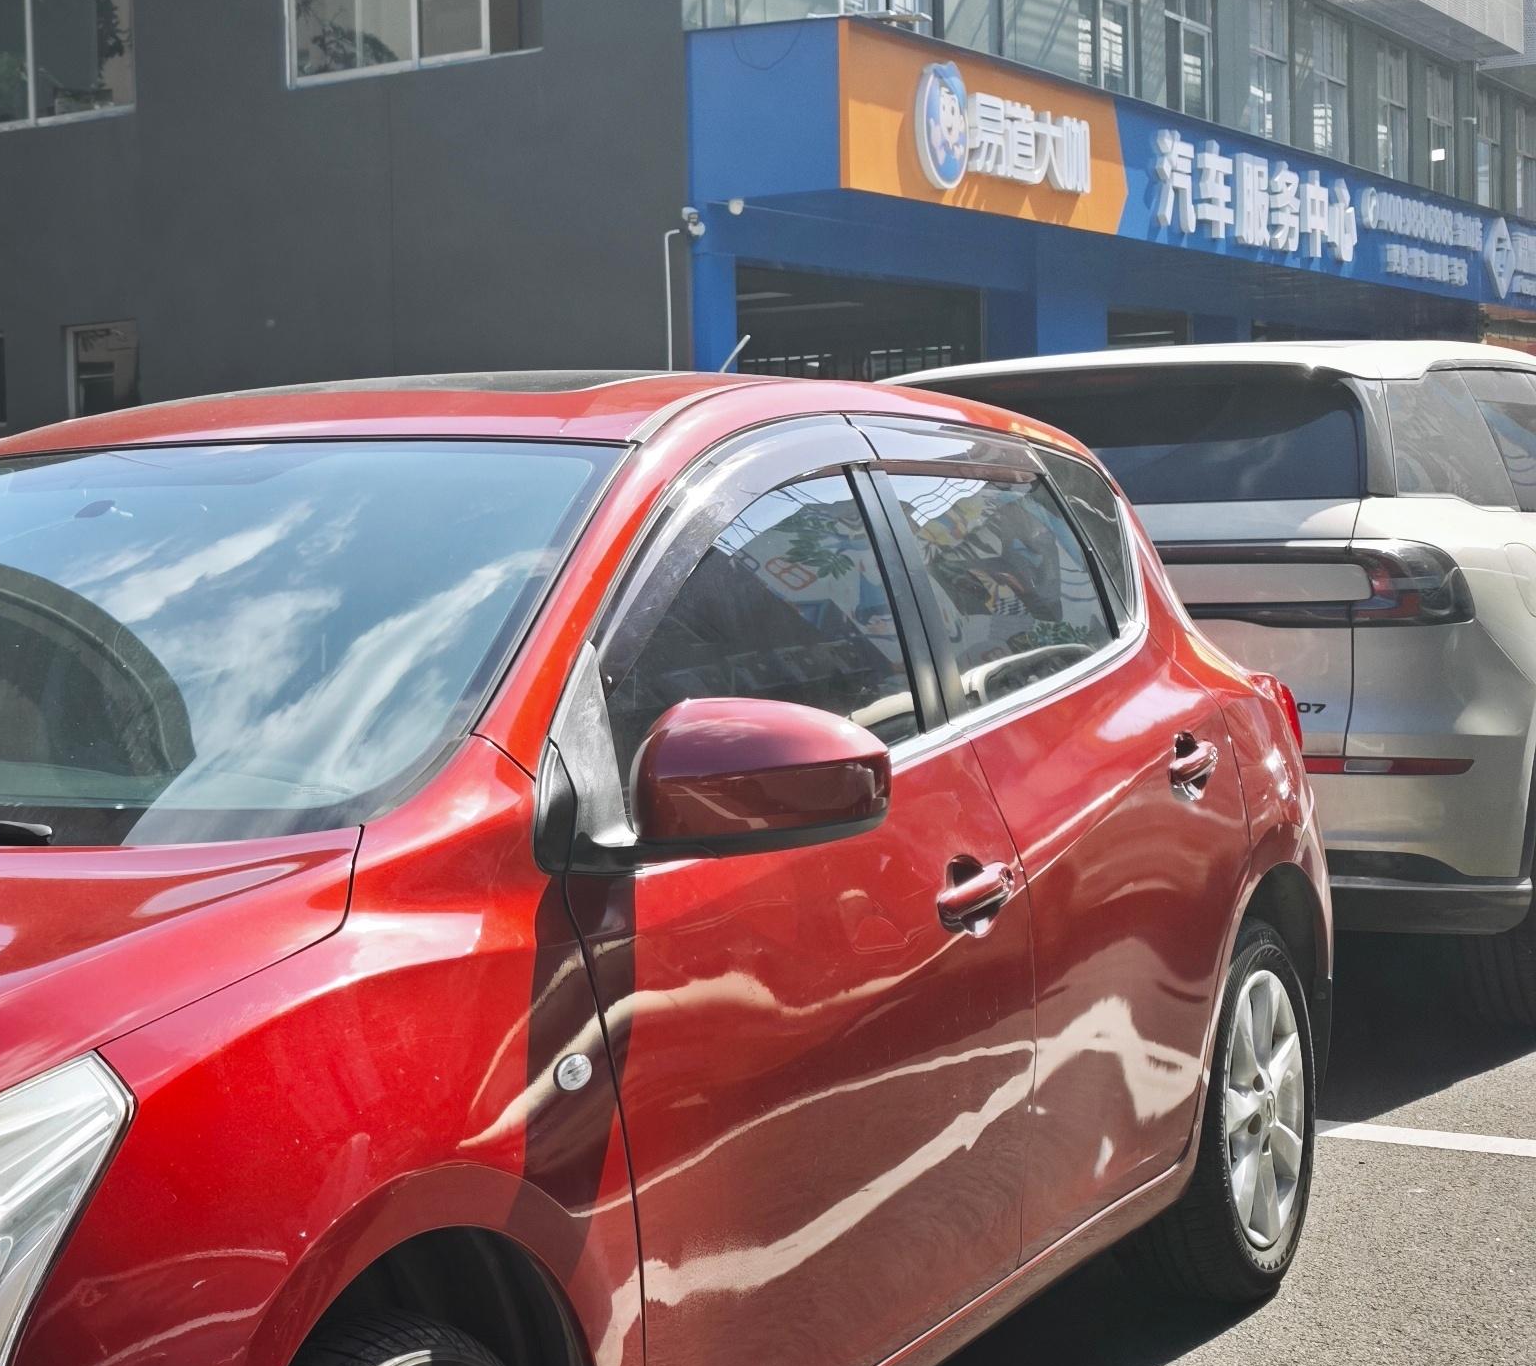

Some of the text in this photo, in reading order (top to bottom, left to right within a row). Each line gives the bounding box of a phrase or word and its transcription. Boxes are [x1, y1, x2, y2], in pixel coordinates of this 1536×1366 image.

[969, 92, 1091, 194] 易道大咖
[1156, 129, 1357, 262] 汽车服务中心
